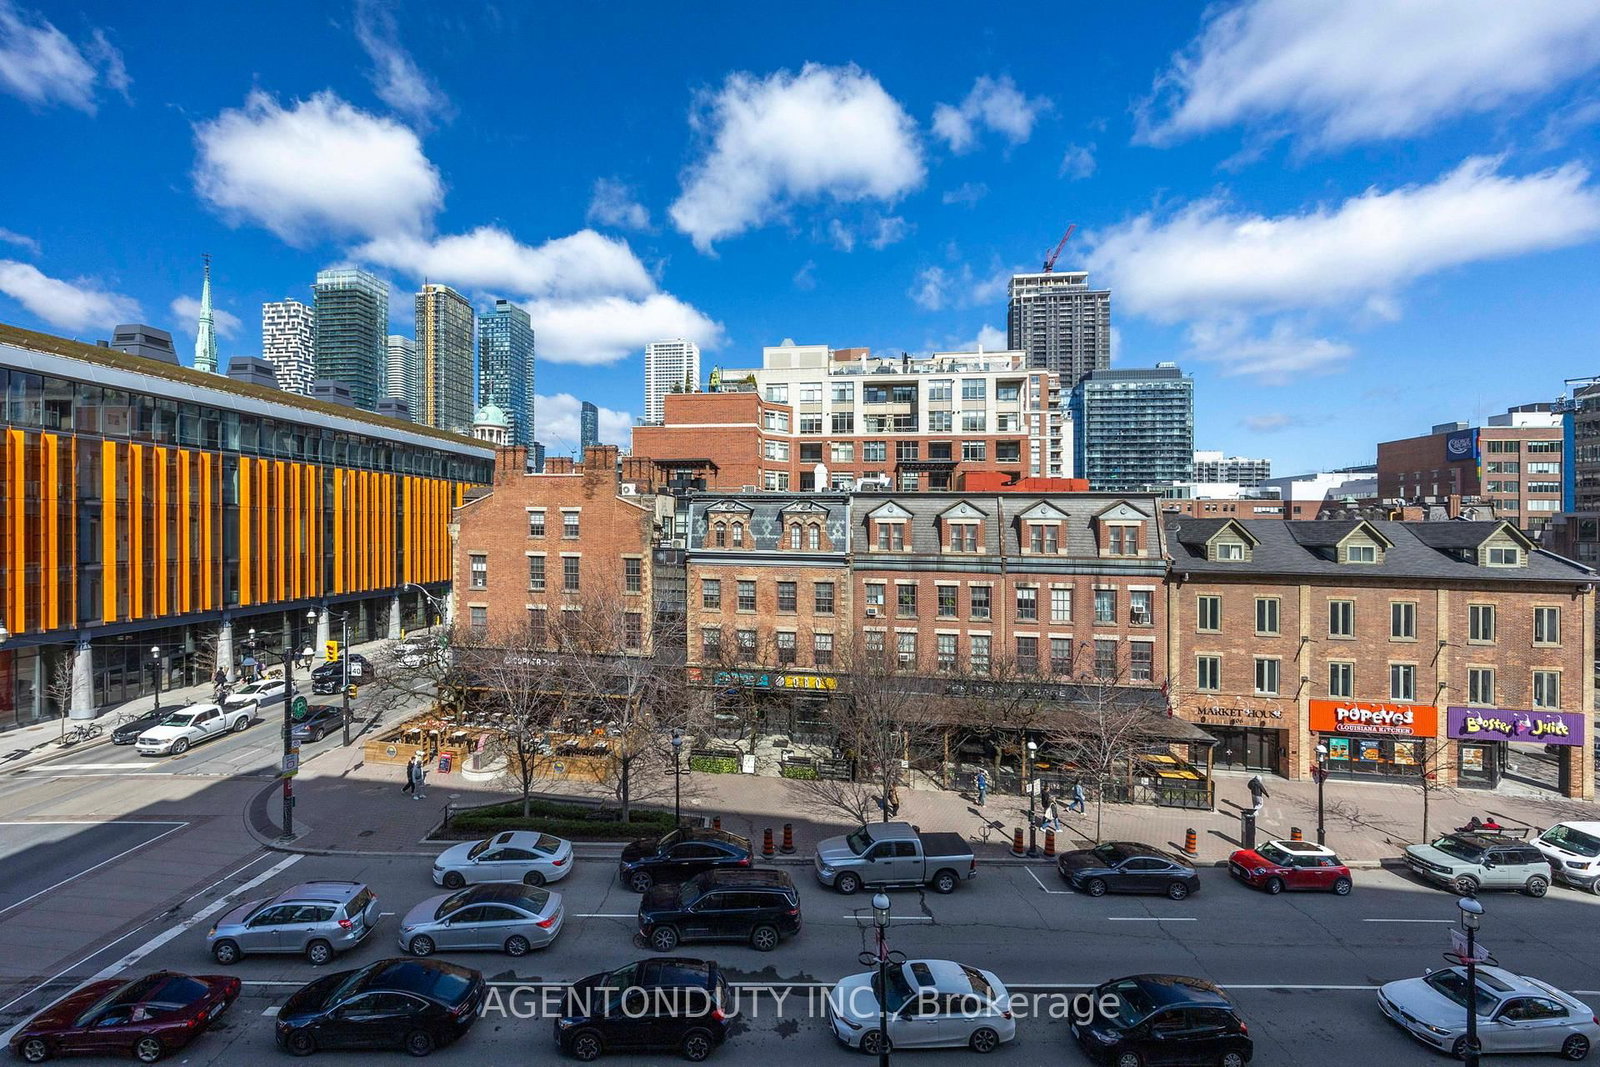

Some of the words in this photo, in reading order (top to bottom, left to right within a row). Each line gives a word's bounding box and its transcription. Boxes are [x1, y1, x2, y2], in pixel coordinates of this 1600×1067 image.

[1197, 707, 1243, 716] MARKET
[1340, 724, 1377, 732] LOUISIANA
[1379, 726, 1411, 734] KITCHEN
[1467, 717, 1512, 732] Boster
[1531, 719, 1569, 735] Juice
